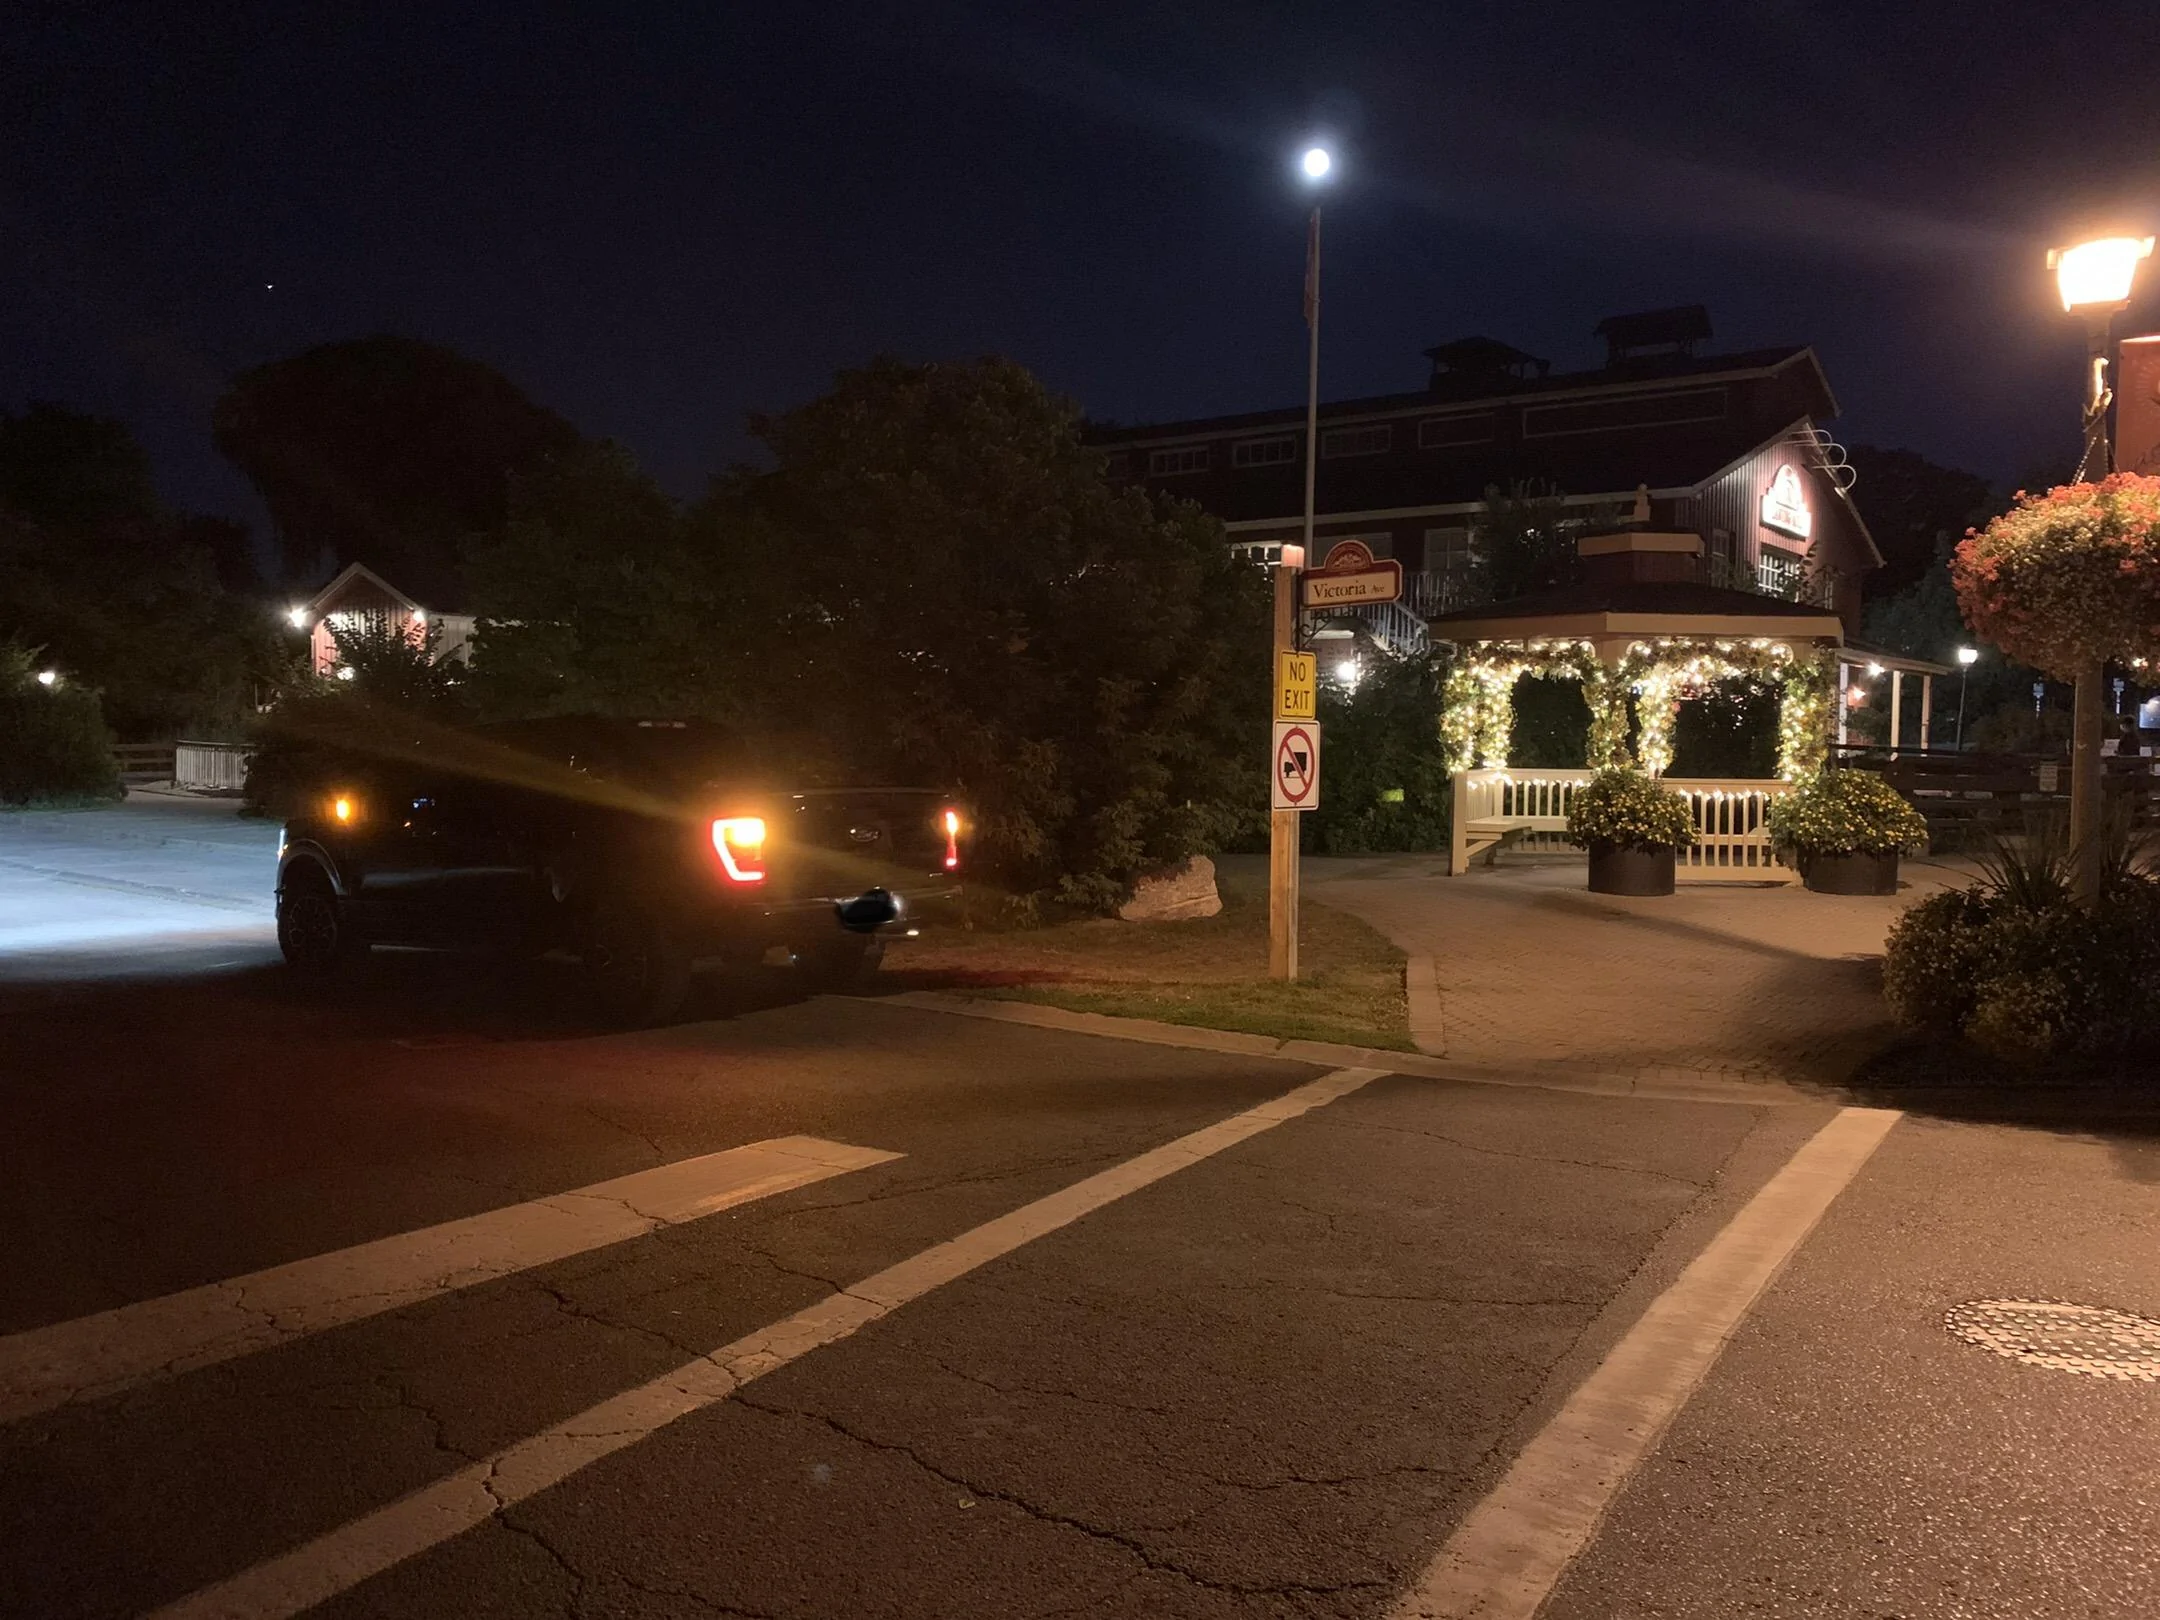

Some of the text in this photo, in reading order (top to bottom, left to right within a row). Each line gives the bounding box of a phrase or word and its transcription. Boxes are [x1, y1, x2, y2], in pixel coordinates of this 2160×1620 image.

[1313, 580, 1385, 598] Victoria Ave
[1289, 661, 1306, 682] NO
[1284, 688, 1310, 710] EXIT
